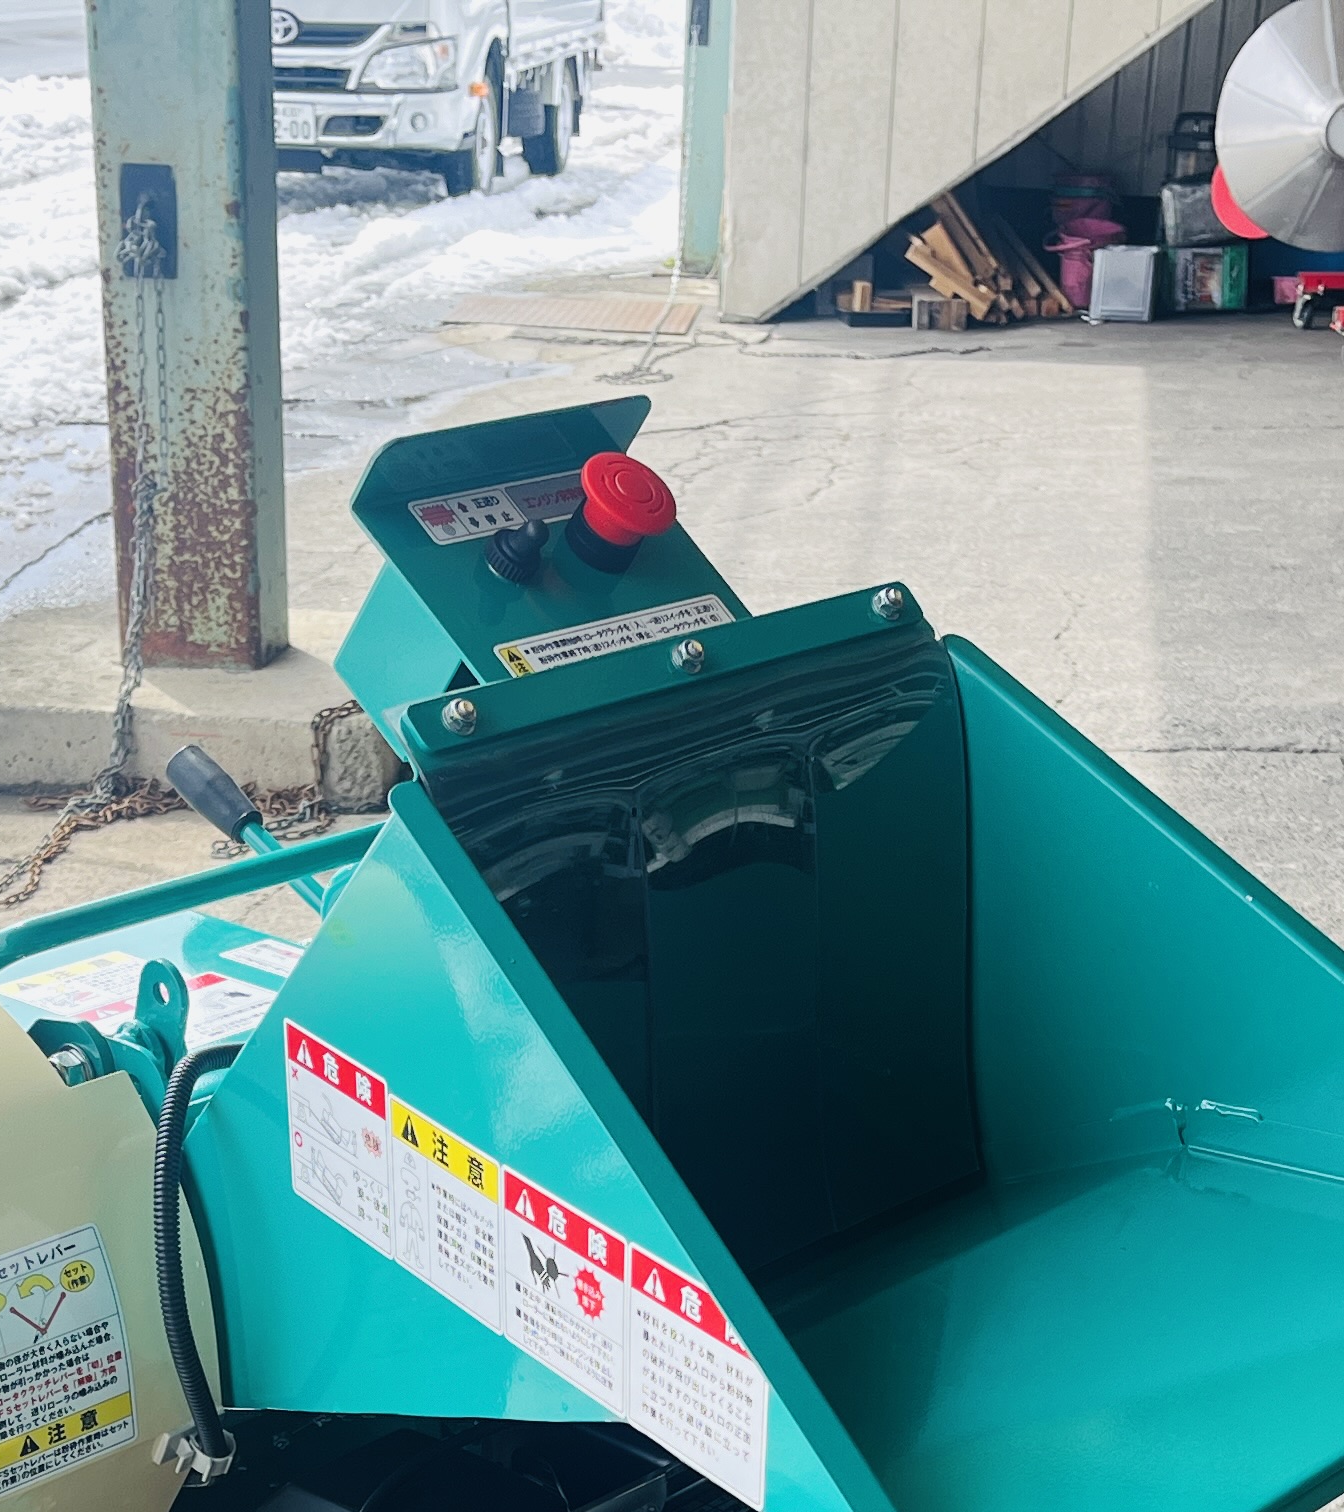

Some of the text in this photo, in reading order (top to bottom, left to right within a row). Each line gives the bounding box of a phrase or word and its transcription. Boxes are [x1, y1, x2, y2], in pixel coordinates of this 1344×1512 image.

[322, 1048, 372, 1107] 危険
[432, 1129, 483, 1190] 注意
[547, 1200, 607, 1268] 危険
[45, 1408, 99, 1445] 注意
